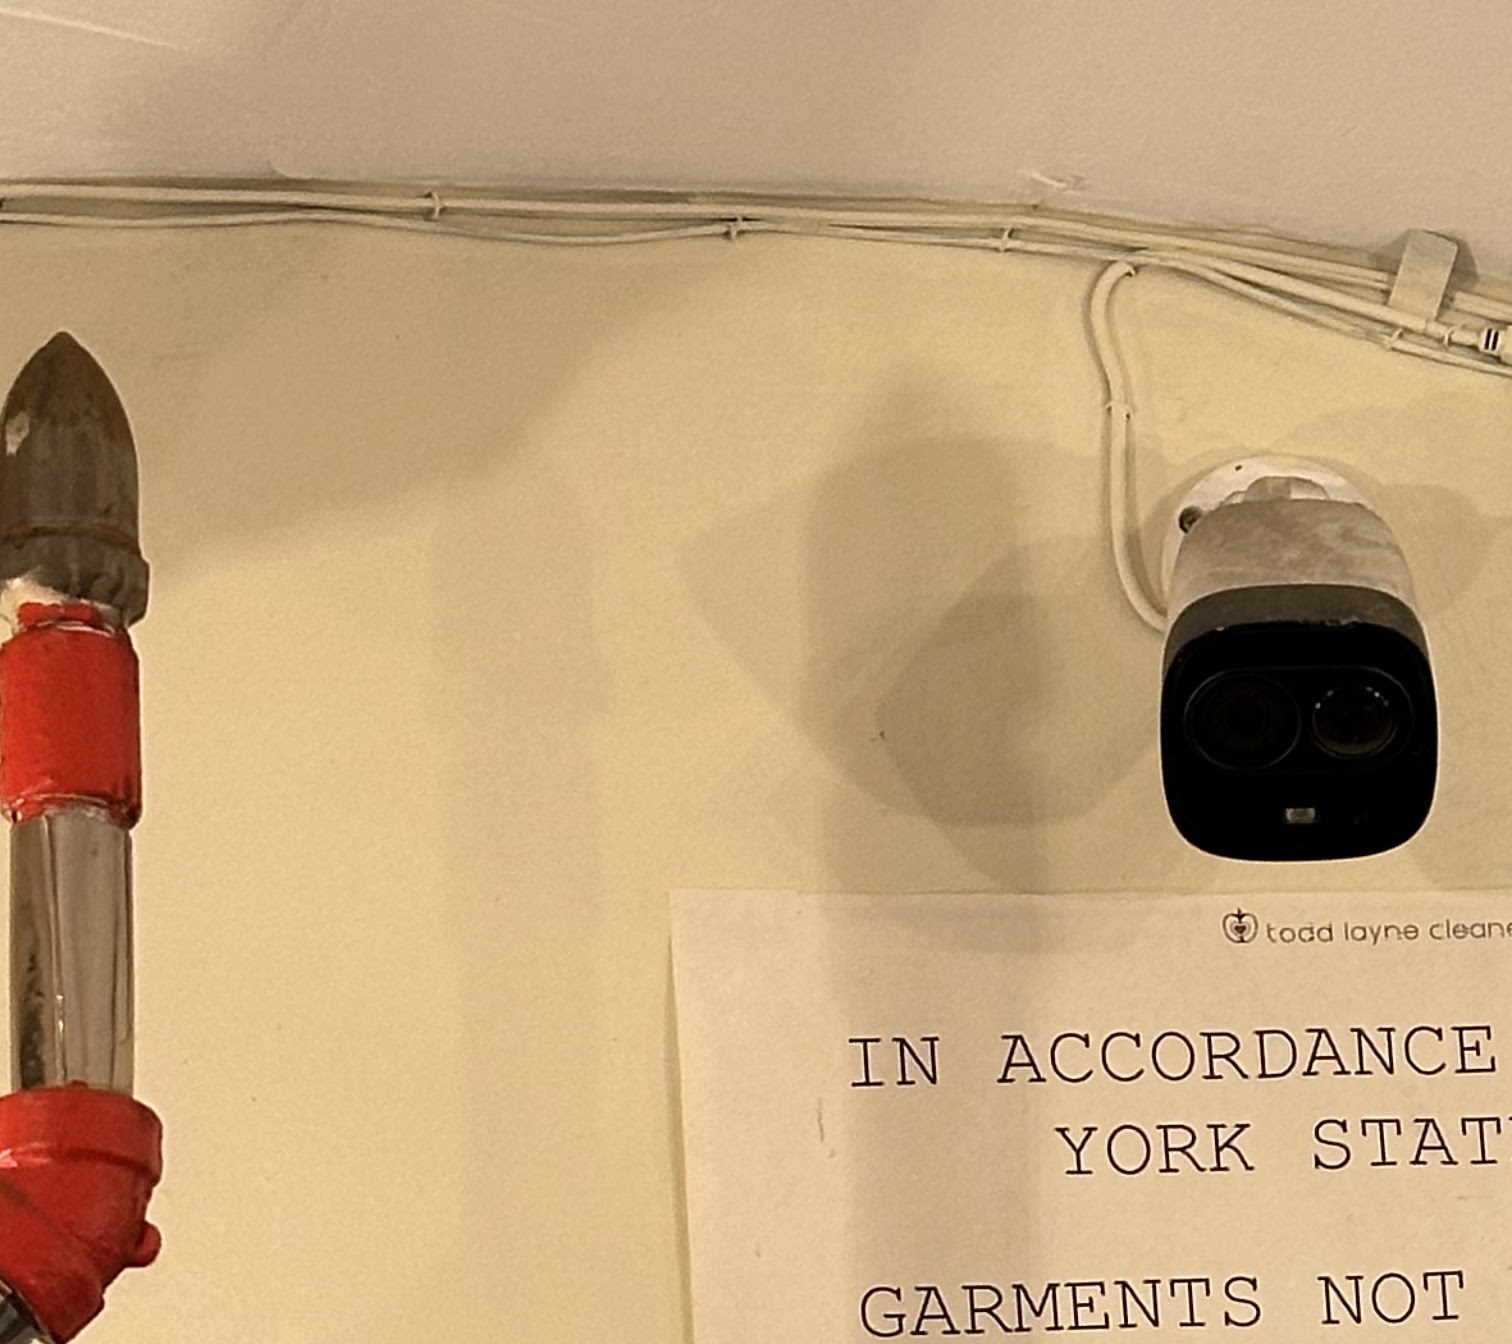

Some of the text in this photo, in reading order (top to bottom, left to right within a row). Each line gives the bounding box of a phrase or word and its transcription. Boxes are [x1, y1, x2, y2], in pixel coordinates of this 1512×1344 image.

[1265, 922, 1334, 944] todd
[1343, 921, 1420, 947] layne
[848, 1035, 941, 1091] IN
[996, 1025, 1497, 1086] ACCORDANCE
[1053, 1122, 1256, 1176] YORK
[861, 1276, 1262, 1341] GARMENTS
[1317, 1269, 1465, 1325] NOT
